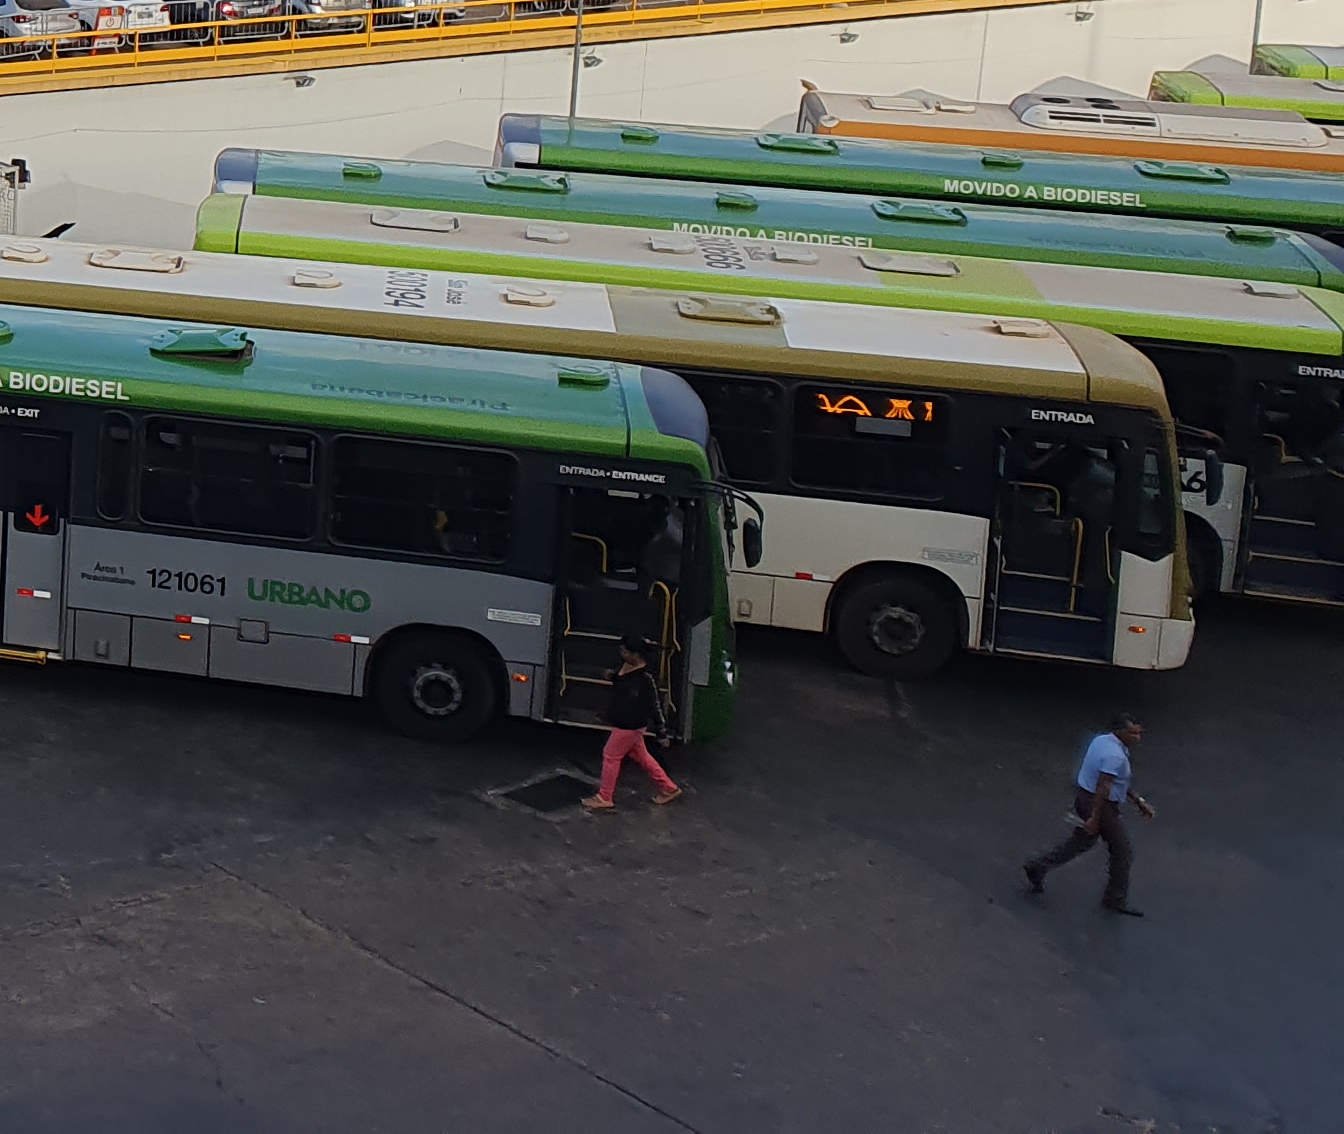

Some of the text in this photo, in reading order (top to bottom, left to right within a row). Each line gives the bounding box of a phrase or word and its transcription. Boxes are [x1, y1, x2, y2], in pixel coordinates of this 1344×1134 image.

[943, 179, 1147, 208] MOVIDO A BIODIESEL
[9, 371, 130, 401] BIODIESEL
[17, 407, 40, 418] EXIT
[1031, 409, 1095, 425] ENTRADA
[559, 464, 667, 484] ENTRADA ENTRANCE
[146, 568, 226, 597] 121061
[247, 577, 371, 613] URBANO
